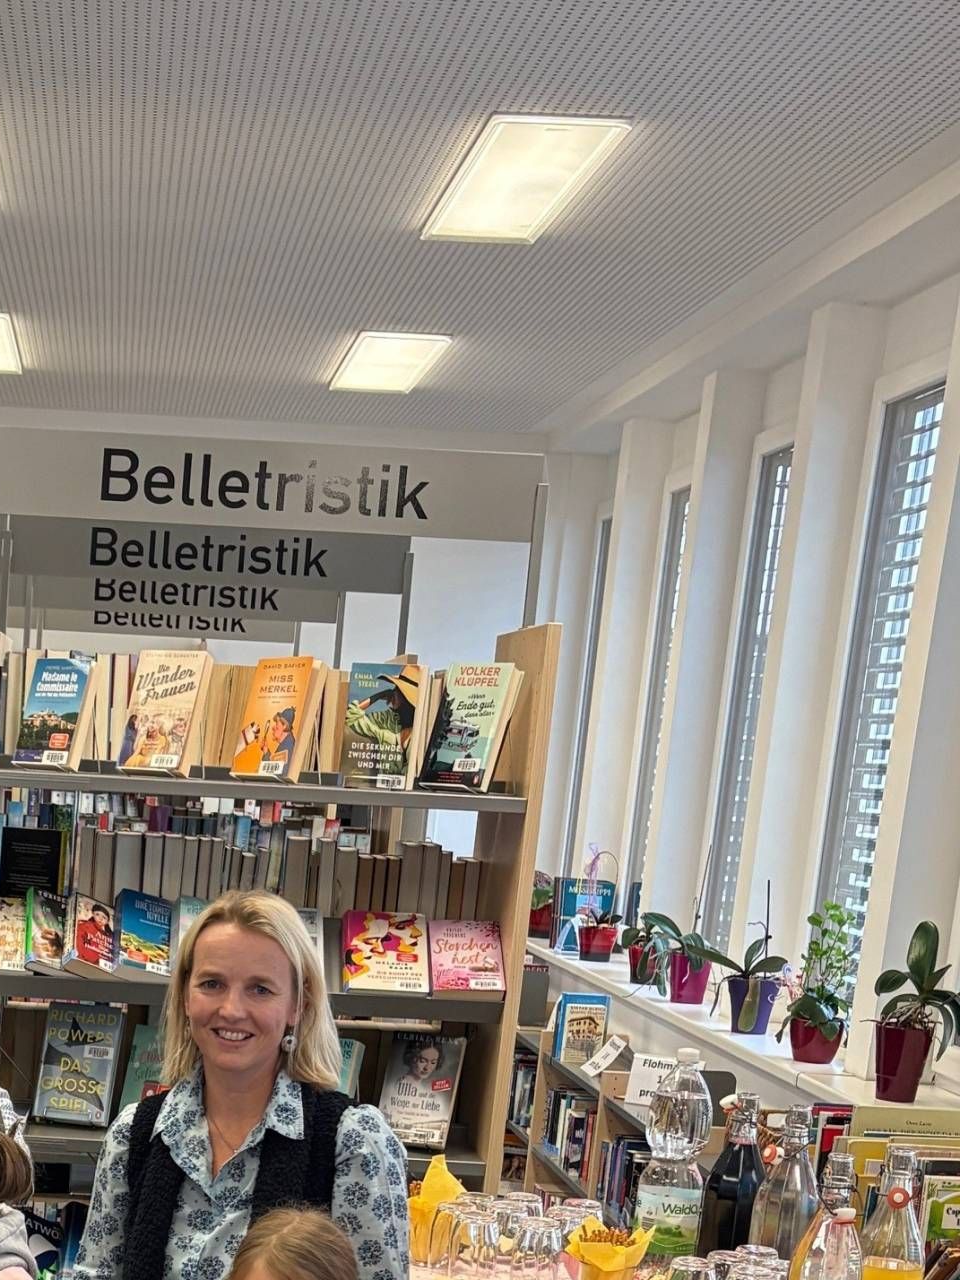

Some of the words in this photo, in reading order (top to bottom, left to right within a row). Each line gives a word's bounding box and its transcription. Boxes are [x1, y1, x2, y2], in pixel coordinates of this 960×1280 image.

[100, 447, 430, 520] Belletristik
[89, 527, 328, 578] Belletristik
[93, 578, 278, 611] Belletristik
[41, 671, 69, 683] Madame
[354, 672, 373, 681] EMMA
[460, 666, 500, 676] VOLKER
[136, 667, 195, 692] Wunder
[269, 674, 293, 683] MISS
[454, 676, 499, 687] KLÜPFEL
[36, 681, 79, 693] Commissaire
[142, 679, 196, 706] Frauen
[259, 685, 298, 693] MERKEL
[456, 700, 477, 710] Ende
[352, 742, 364, 750] DIE
[366, 743, 401, 752] SEKUNDE
[348, 751, 387, 760] ZWISCHEN
[388, 753, 402, 761] DIR
[357, 761, 374, 769] UND
[376, 762, 390, 770] MIR
[433, 938, 498, 955] Storchen
[451, 952, 480, 964] nest
[51, 1008, 118, 1026] RICHARD
[48, 1027, 114, 1045] POWERS
[59, 1057, 92, 1073] DAS
[642, 1058, 673, 1070] Flohm
[41, 1076, 107, 1097] GROSSE
[662, 1202, 699, 1216] WaldQ
